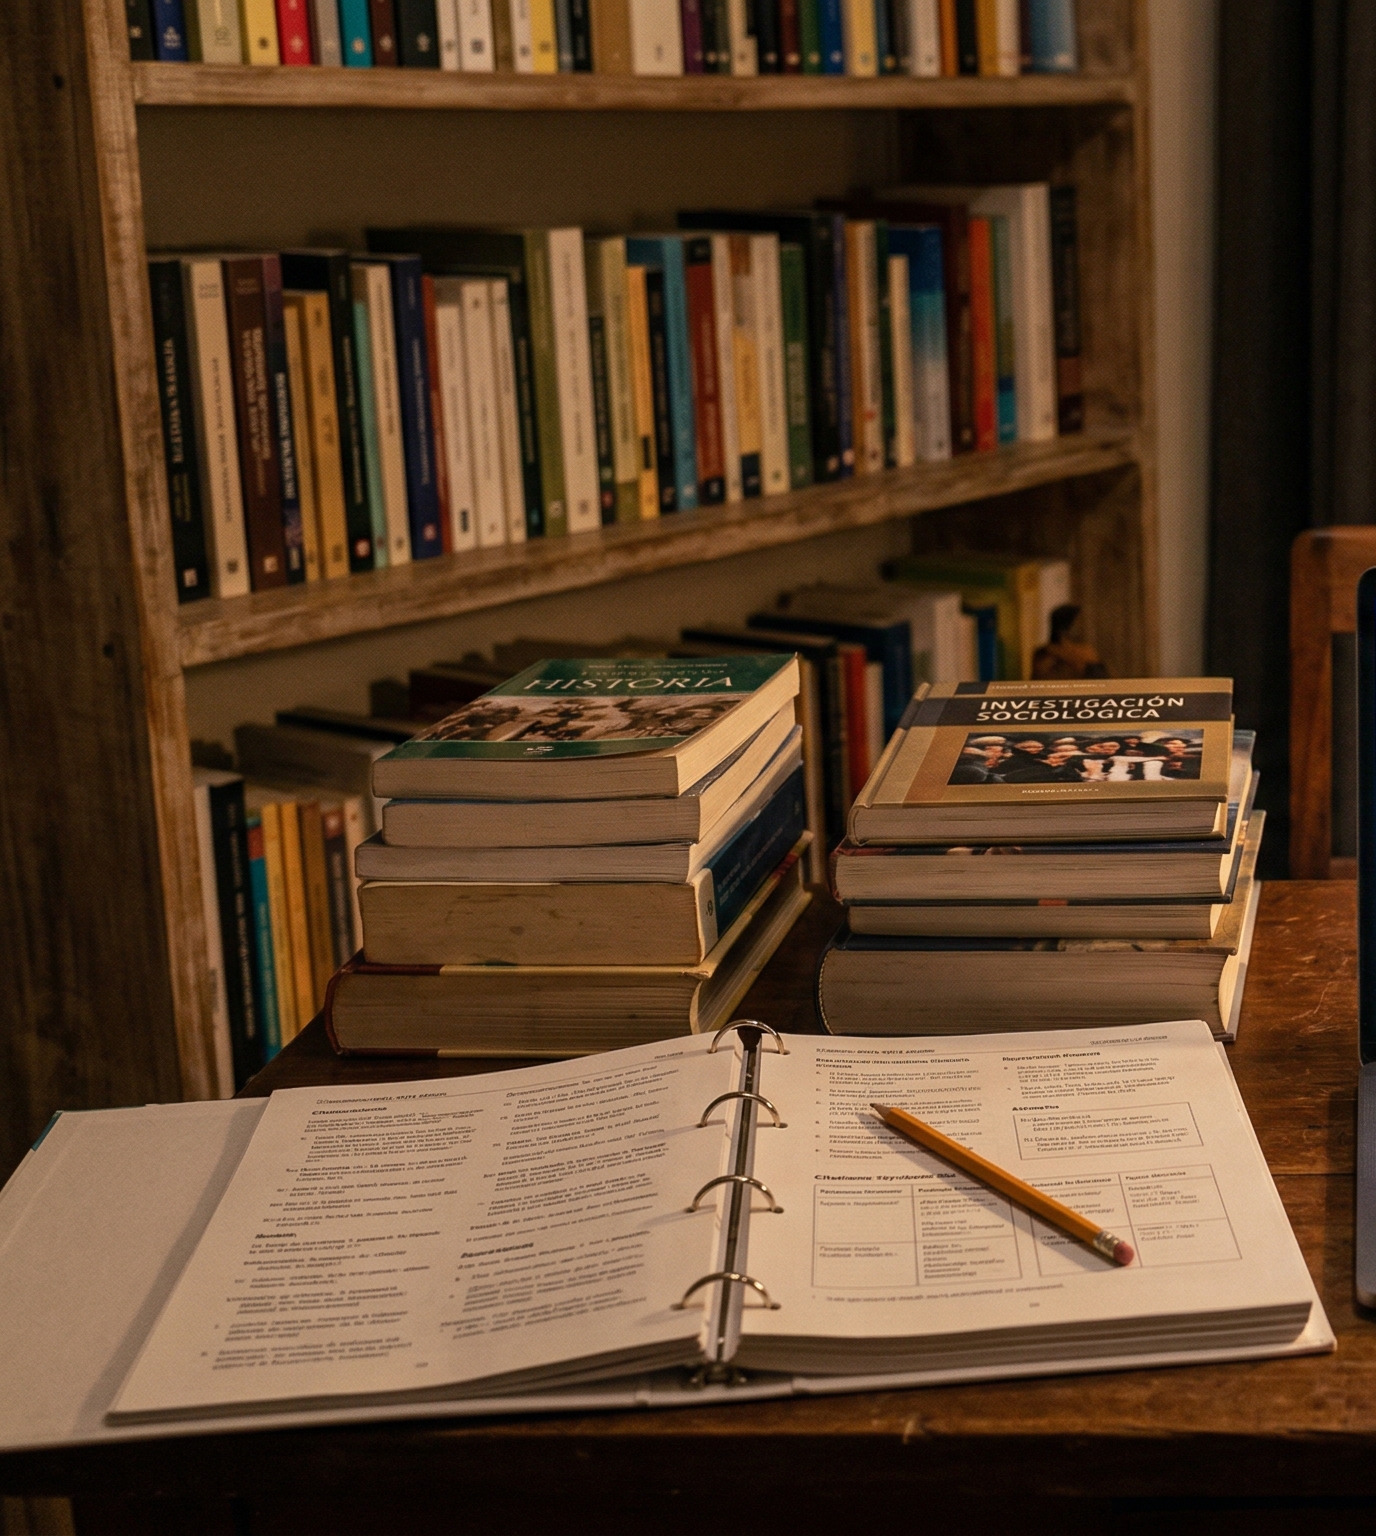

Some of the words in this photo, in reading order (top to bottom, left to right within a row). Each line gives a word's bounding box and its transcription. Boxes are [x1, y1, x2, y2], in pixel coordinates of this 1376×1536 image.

[524, 676, 733, 690] HISTORIA
[980, 695, 1185, 711] INVESTIGACIÓN
[976, 708, 1161, 722] SOCIOLÓGICA
